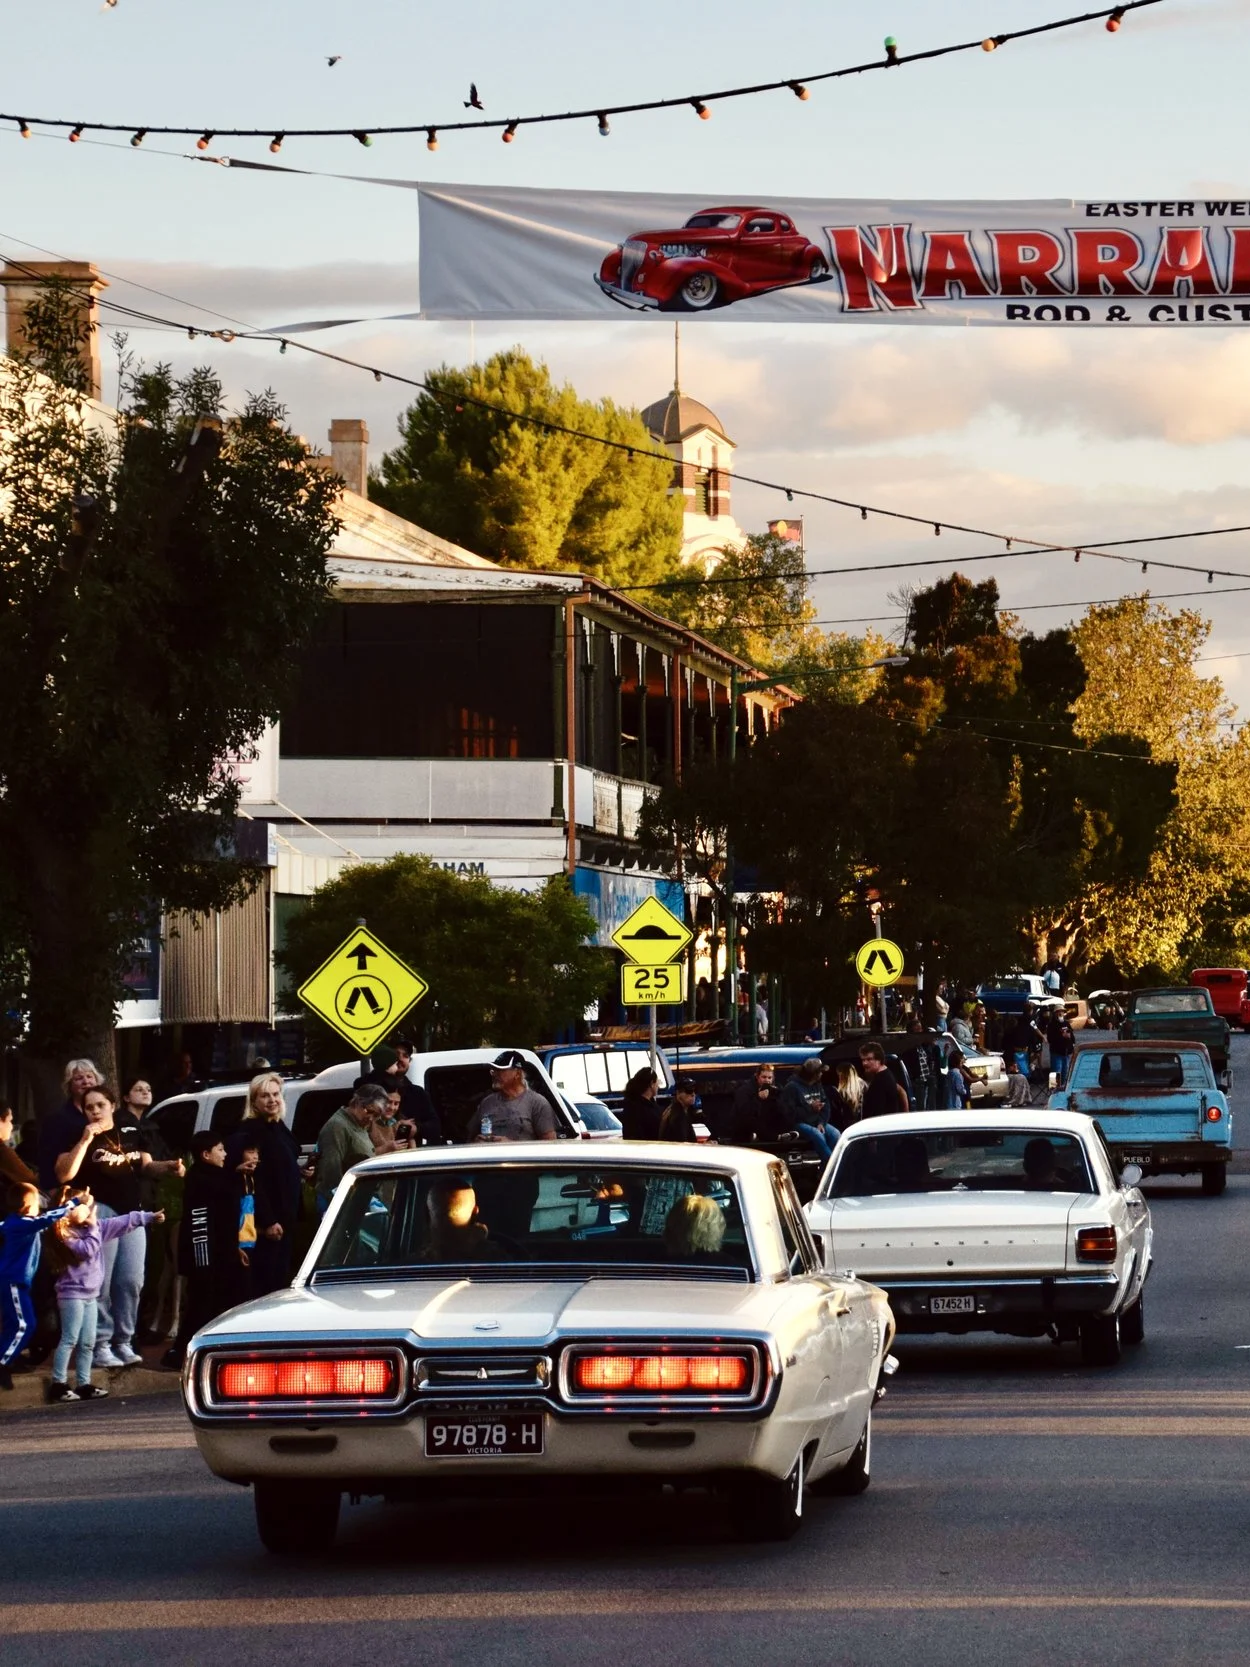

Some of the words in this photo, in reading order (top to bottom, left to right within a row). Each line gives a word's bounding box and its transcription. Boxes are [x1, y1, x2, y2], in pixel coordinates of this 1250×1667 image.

[1086, 202, 1194, 217] EASTER
[1006, 304, 1090, 320] ROD
[1106, 305, 1131, 320] &
[634, 968, 669, 989] 25
[638, 991, 665, 1000] km/h
[934, 1298, 962, 1310] 67452
